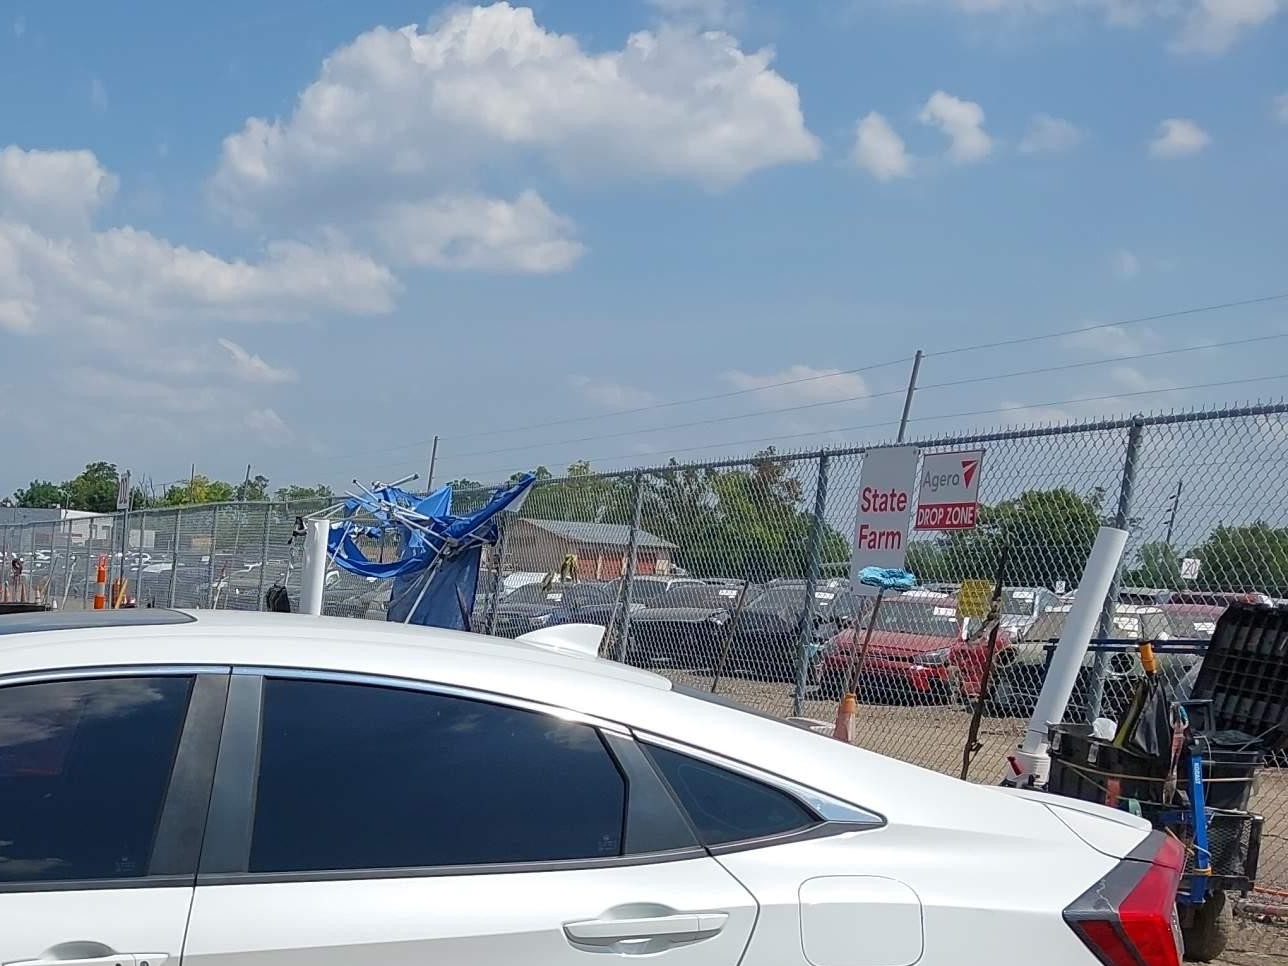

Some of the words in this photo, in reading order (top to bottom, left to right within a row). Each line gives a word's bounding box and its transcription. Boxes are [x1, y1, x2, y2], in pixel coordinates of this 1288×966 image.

[922, 471, 960, 492] Agero
[860, 487, 908, 513] State
[917, 508, 944, 526] DROP
[945, 507, 974, 525] ZONE
[858, 524, 902, 550] Farm
